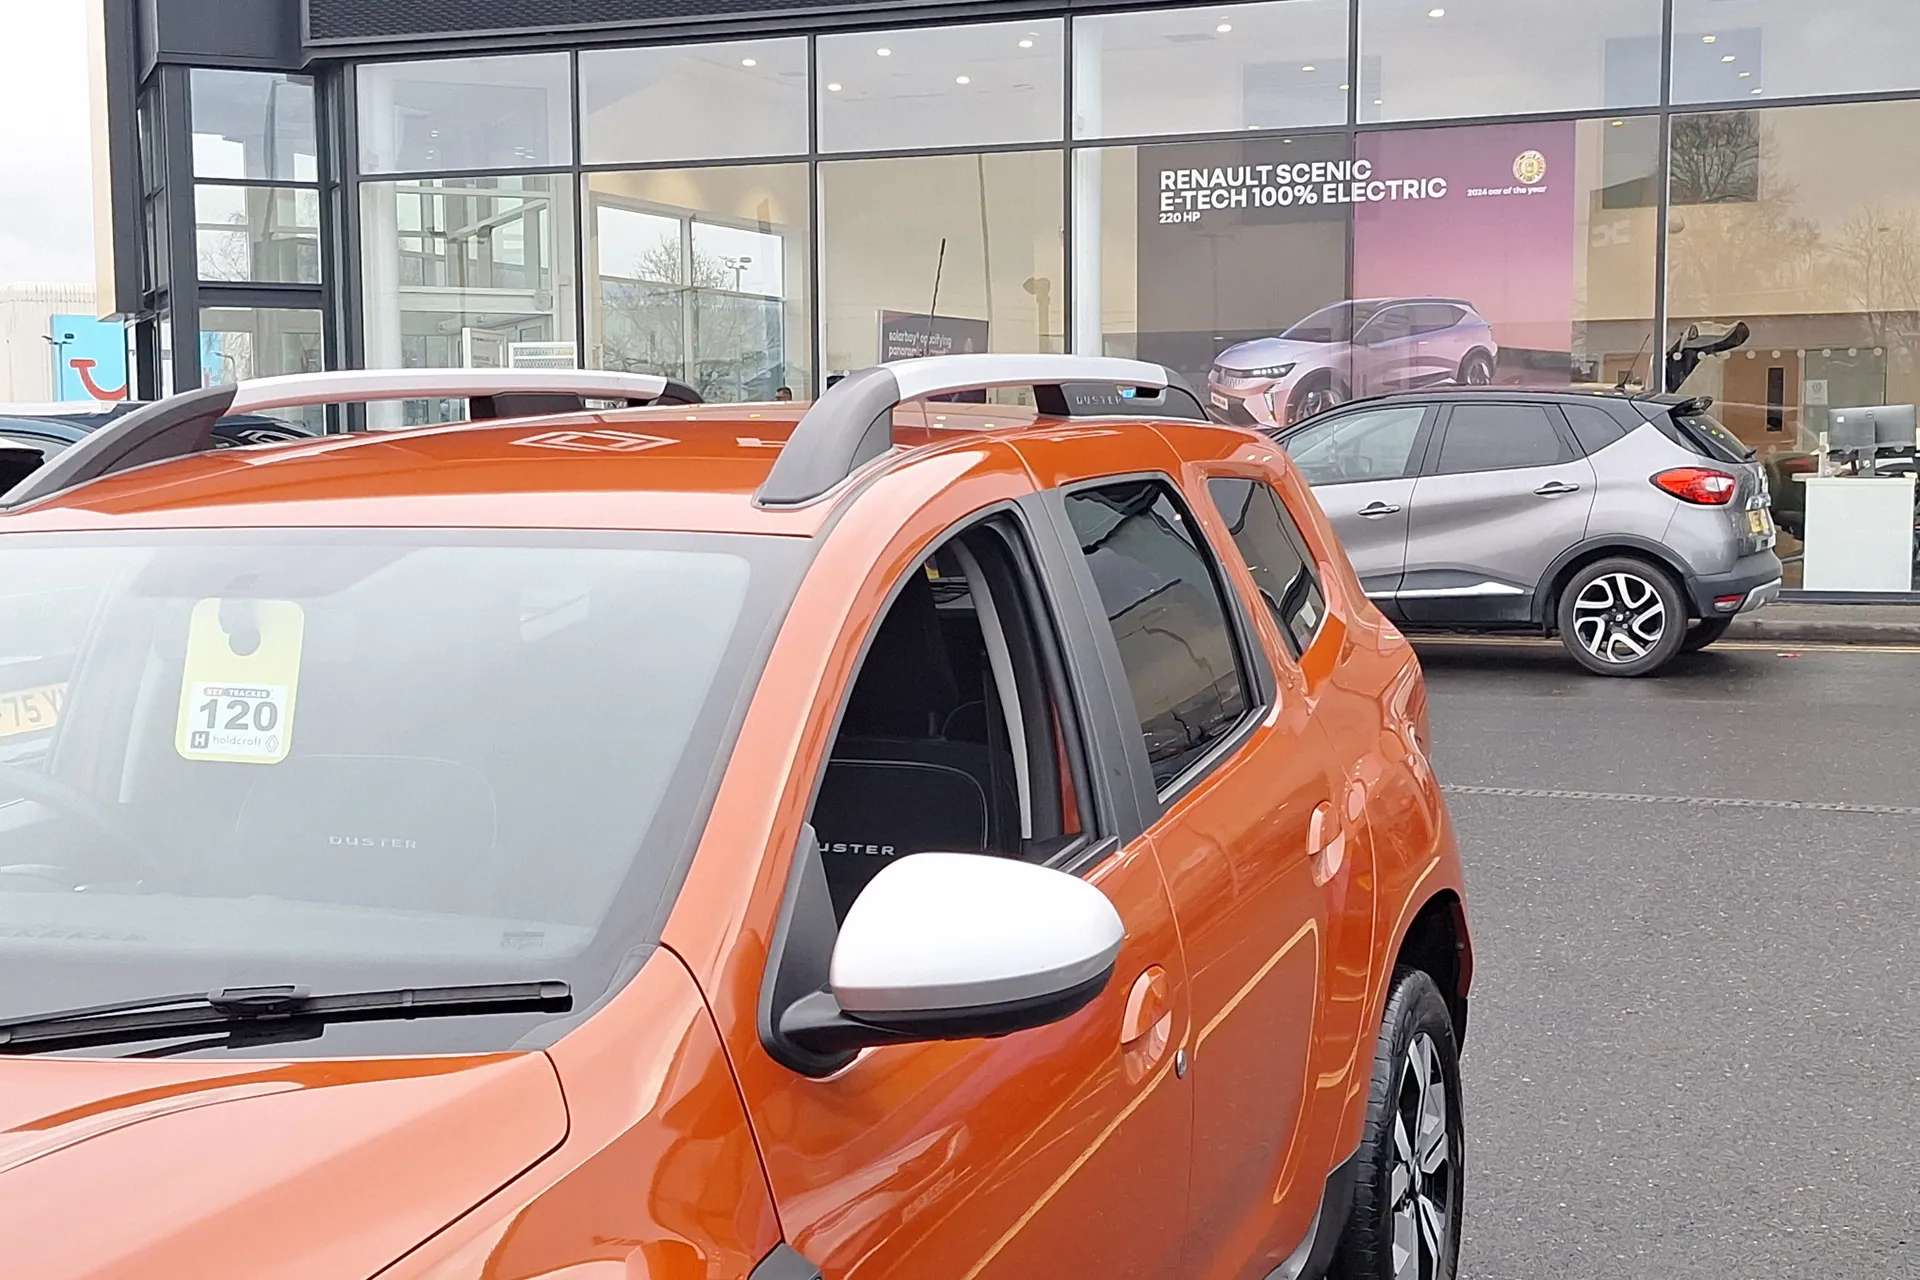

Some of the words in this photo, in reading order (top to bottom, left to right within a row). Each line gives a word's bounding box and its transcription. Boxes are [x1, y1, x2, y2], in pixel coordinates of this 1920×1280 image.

[1160, 165, 1273, 190] RENAULT
[1275, 159, 1372, 185] SCENIC
[1160, 188, 1247, 211] E-TECH
[1251, 185, 1318, 207] 100%
[1322, 177, 1447, 203] ELECTRIC
[1467, 188, 1487, 197] 2024
[1513, 186, 1527, 194] the
[1528, 186, 1547, 195] year
[1159, 212, 1181, 223] 220
[1183, 211, 1201, 223] HP
[200, 698, 278, 731] 120
[213, 735, 261, 747] holdcroft
[328, 835, 417, 849] DUSTER
[817, 842, 895, 856] USTER
